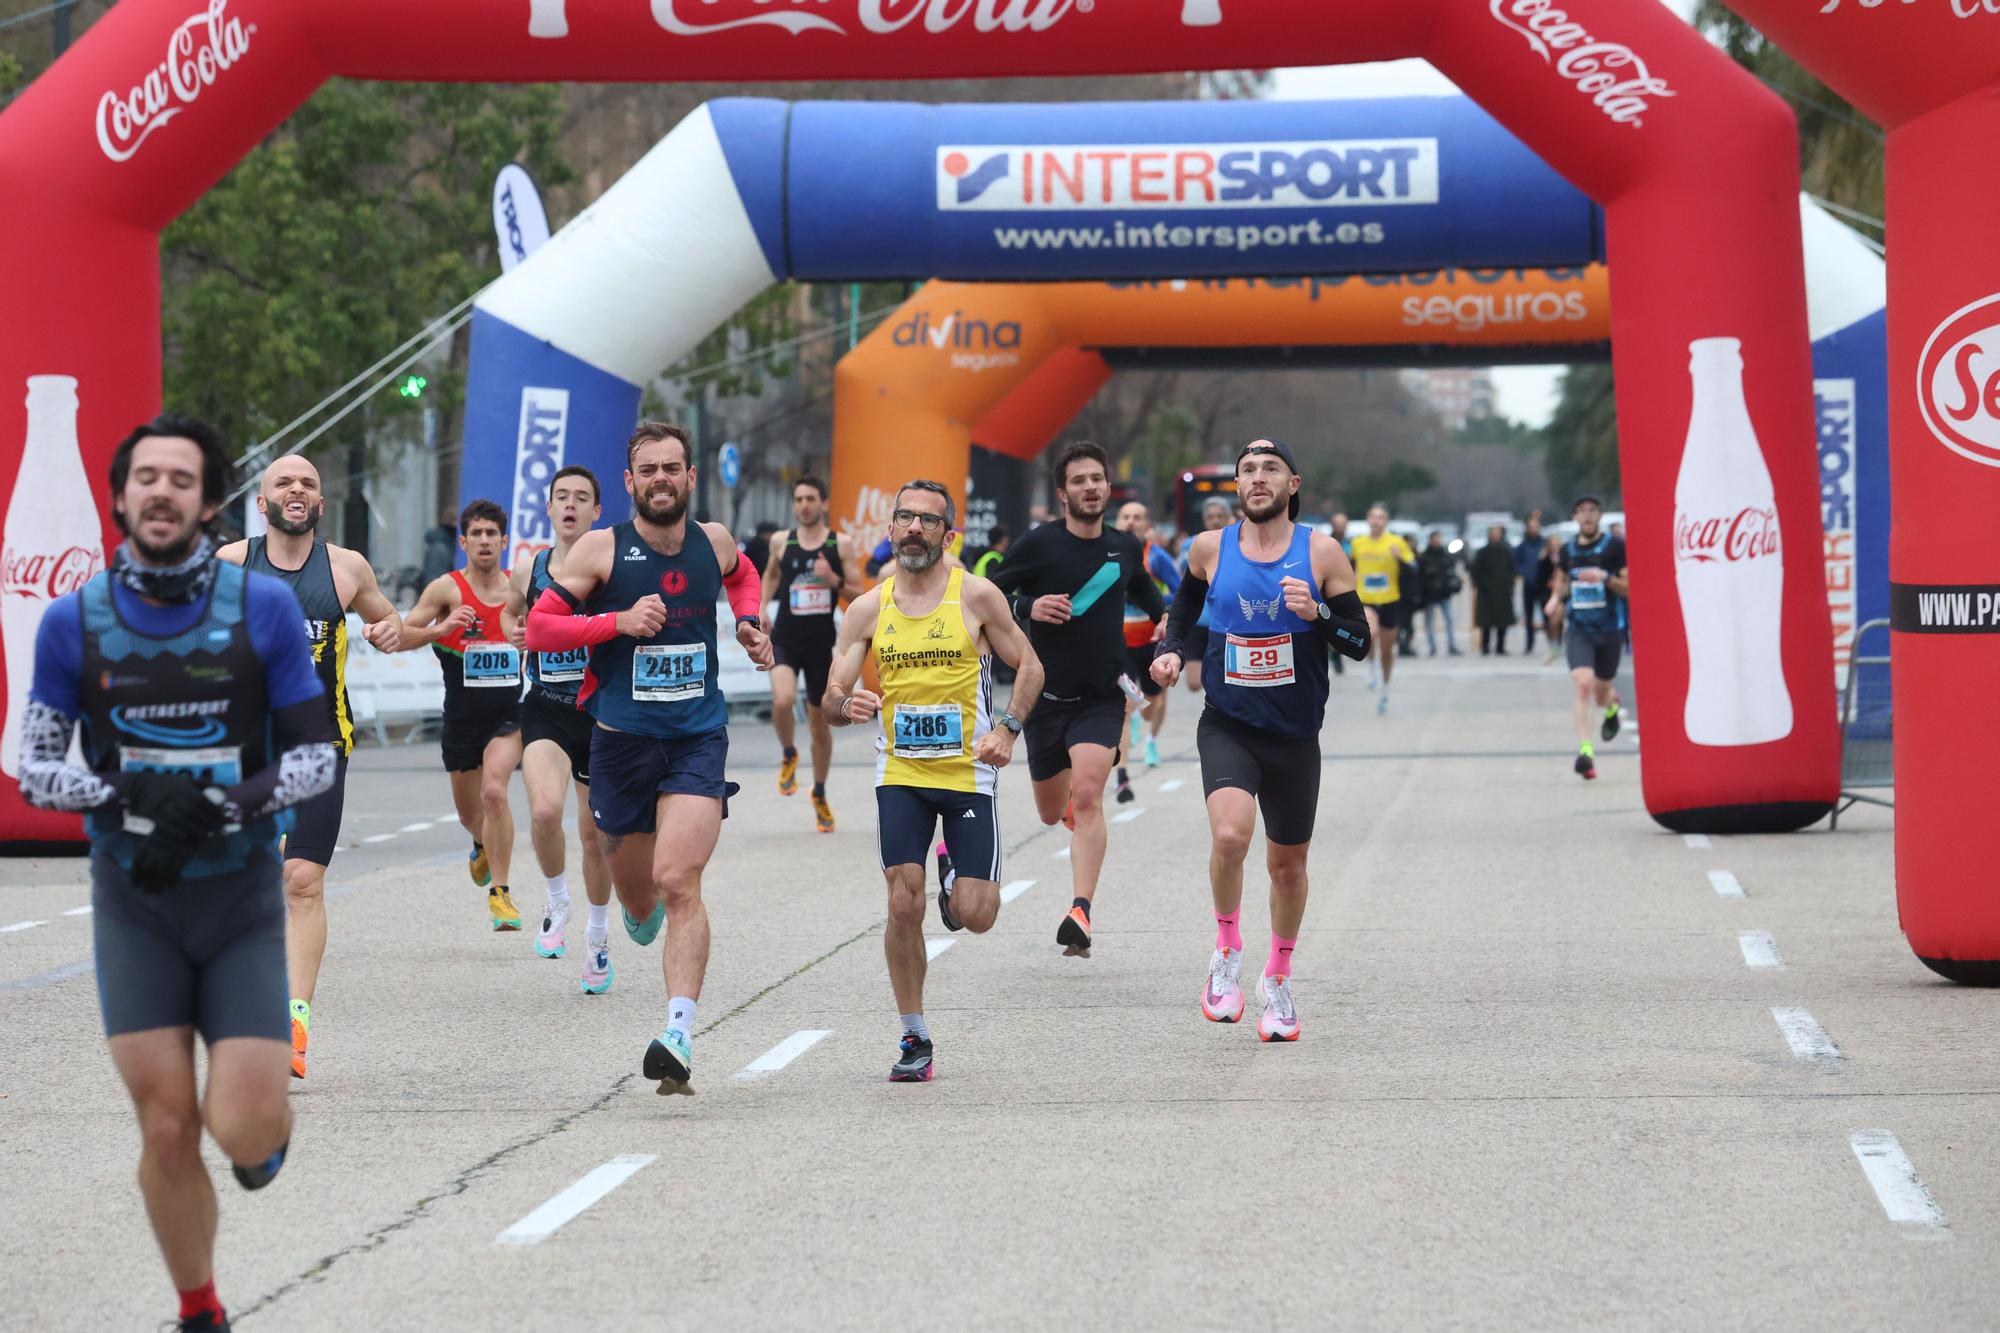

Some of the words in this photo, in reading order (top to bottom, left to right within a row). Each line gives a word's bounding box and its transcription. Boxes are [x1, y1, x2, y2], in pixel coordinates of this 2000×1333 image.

[96, 0, 251, 162] Coca-Cola
[1022, 147, 1419, 205] INTERSPORT
[994, 218, 1385, 250] www.intersport.es
[1401, 289, 1588, 332] seguros
[892, 309, 1022, 350] divina
[1676, 506, 1778, 563] Coca-Cola
[3, 546, 101, 600] Coca-Col
[472, 652, 510, 670] 2078
[880, 644, 897, 655] s.d.
[881, 648, 962, 663] correcaminos
[1249, 649, 1279, 667] 29
[645, 655, 694, 678] 2418
[888, 660, 954, 671] VALENCIA
[541, 689, 576, 704] NIKE
[903, 715, 948, 738] 2186
